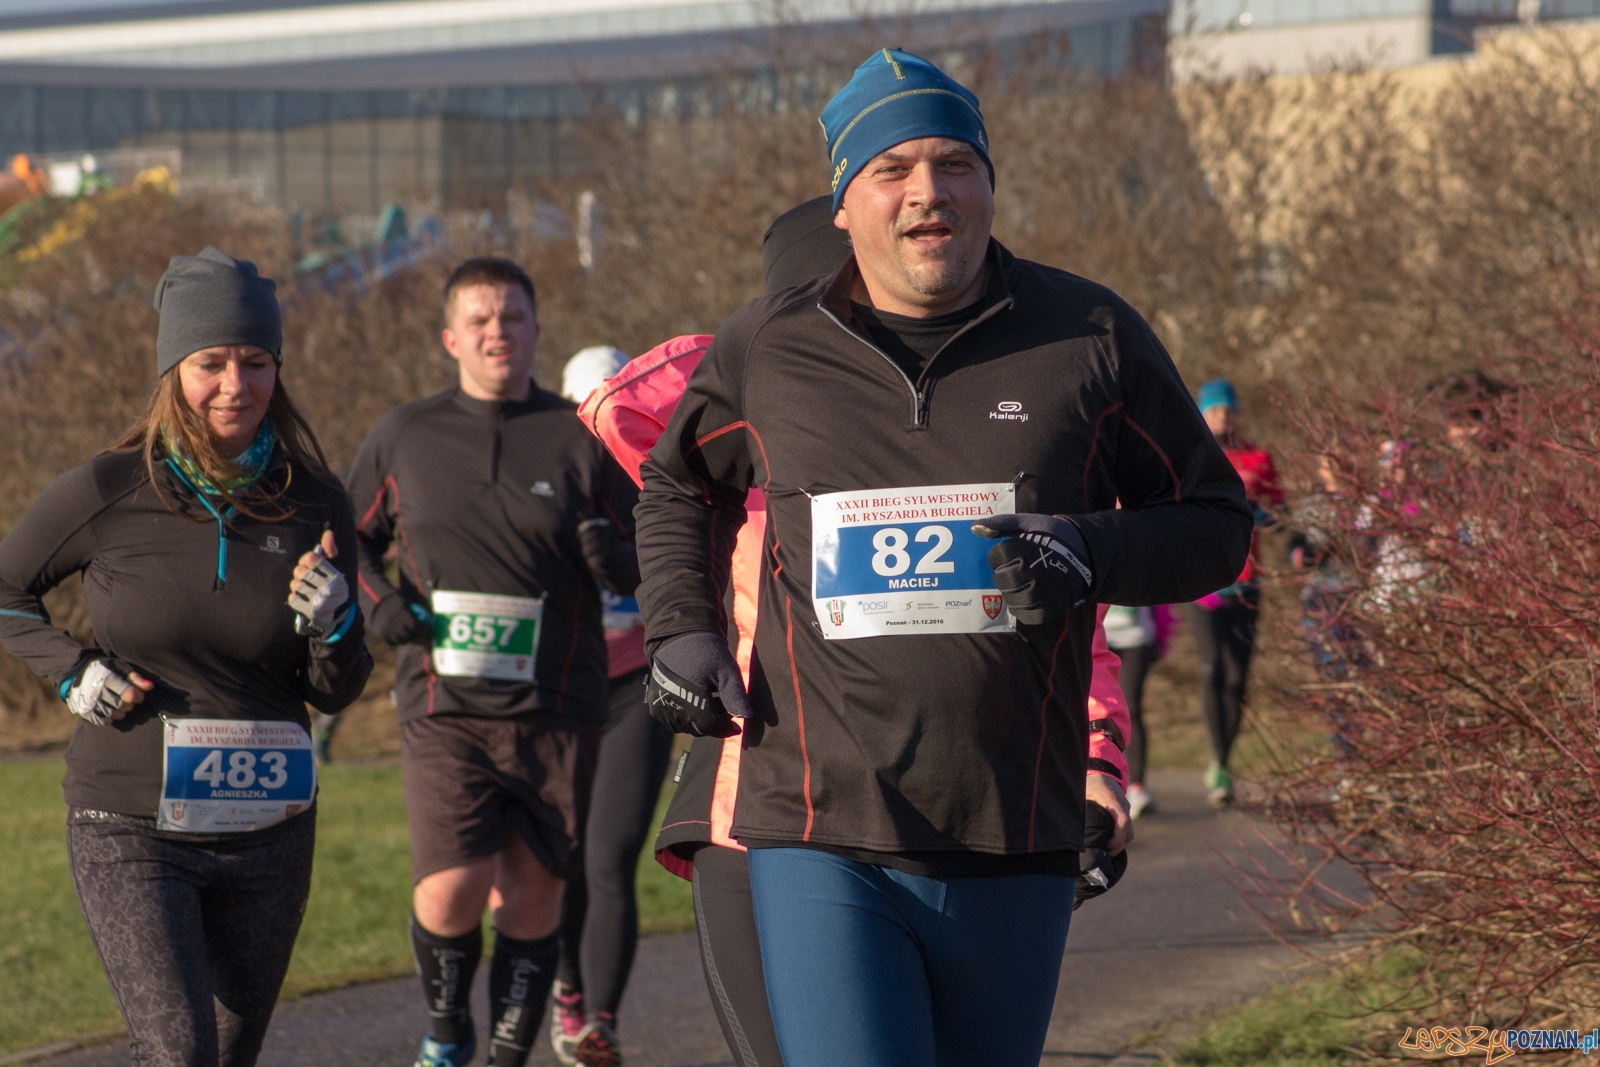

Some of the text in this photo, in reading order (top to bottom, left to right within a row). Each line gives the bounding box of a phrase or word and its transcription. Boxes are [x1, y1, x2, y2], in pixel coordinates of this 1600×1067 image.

[989, 411, 1028, 422] Kalenji
[836, 492, 1000, 510] XXXII BIEG SYLWESTROWY
[842, 506, 994, 524] IM. RYSZARDA BURGIELA
[871, 525, 955, 577] 82
[888, 577, 939, 590] MACIEJ
[862, 600, 890, 613] posir
[449, 614, 520, 647] 657
[186, 726, 212, 734] XXXII
[215, 726, 238, 735] BIEG
[207, 736, 256, 746] RYSZARDA
[258, 737, 301, 746] BURGIELA
[193, 750, 288, 790] 483
[210, 790, 268, 799] AGNIESZKA
